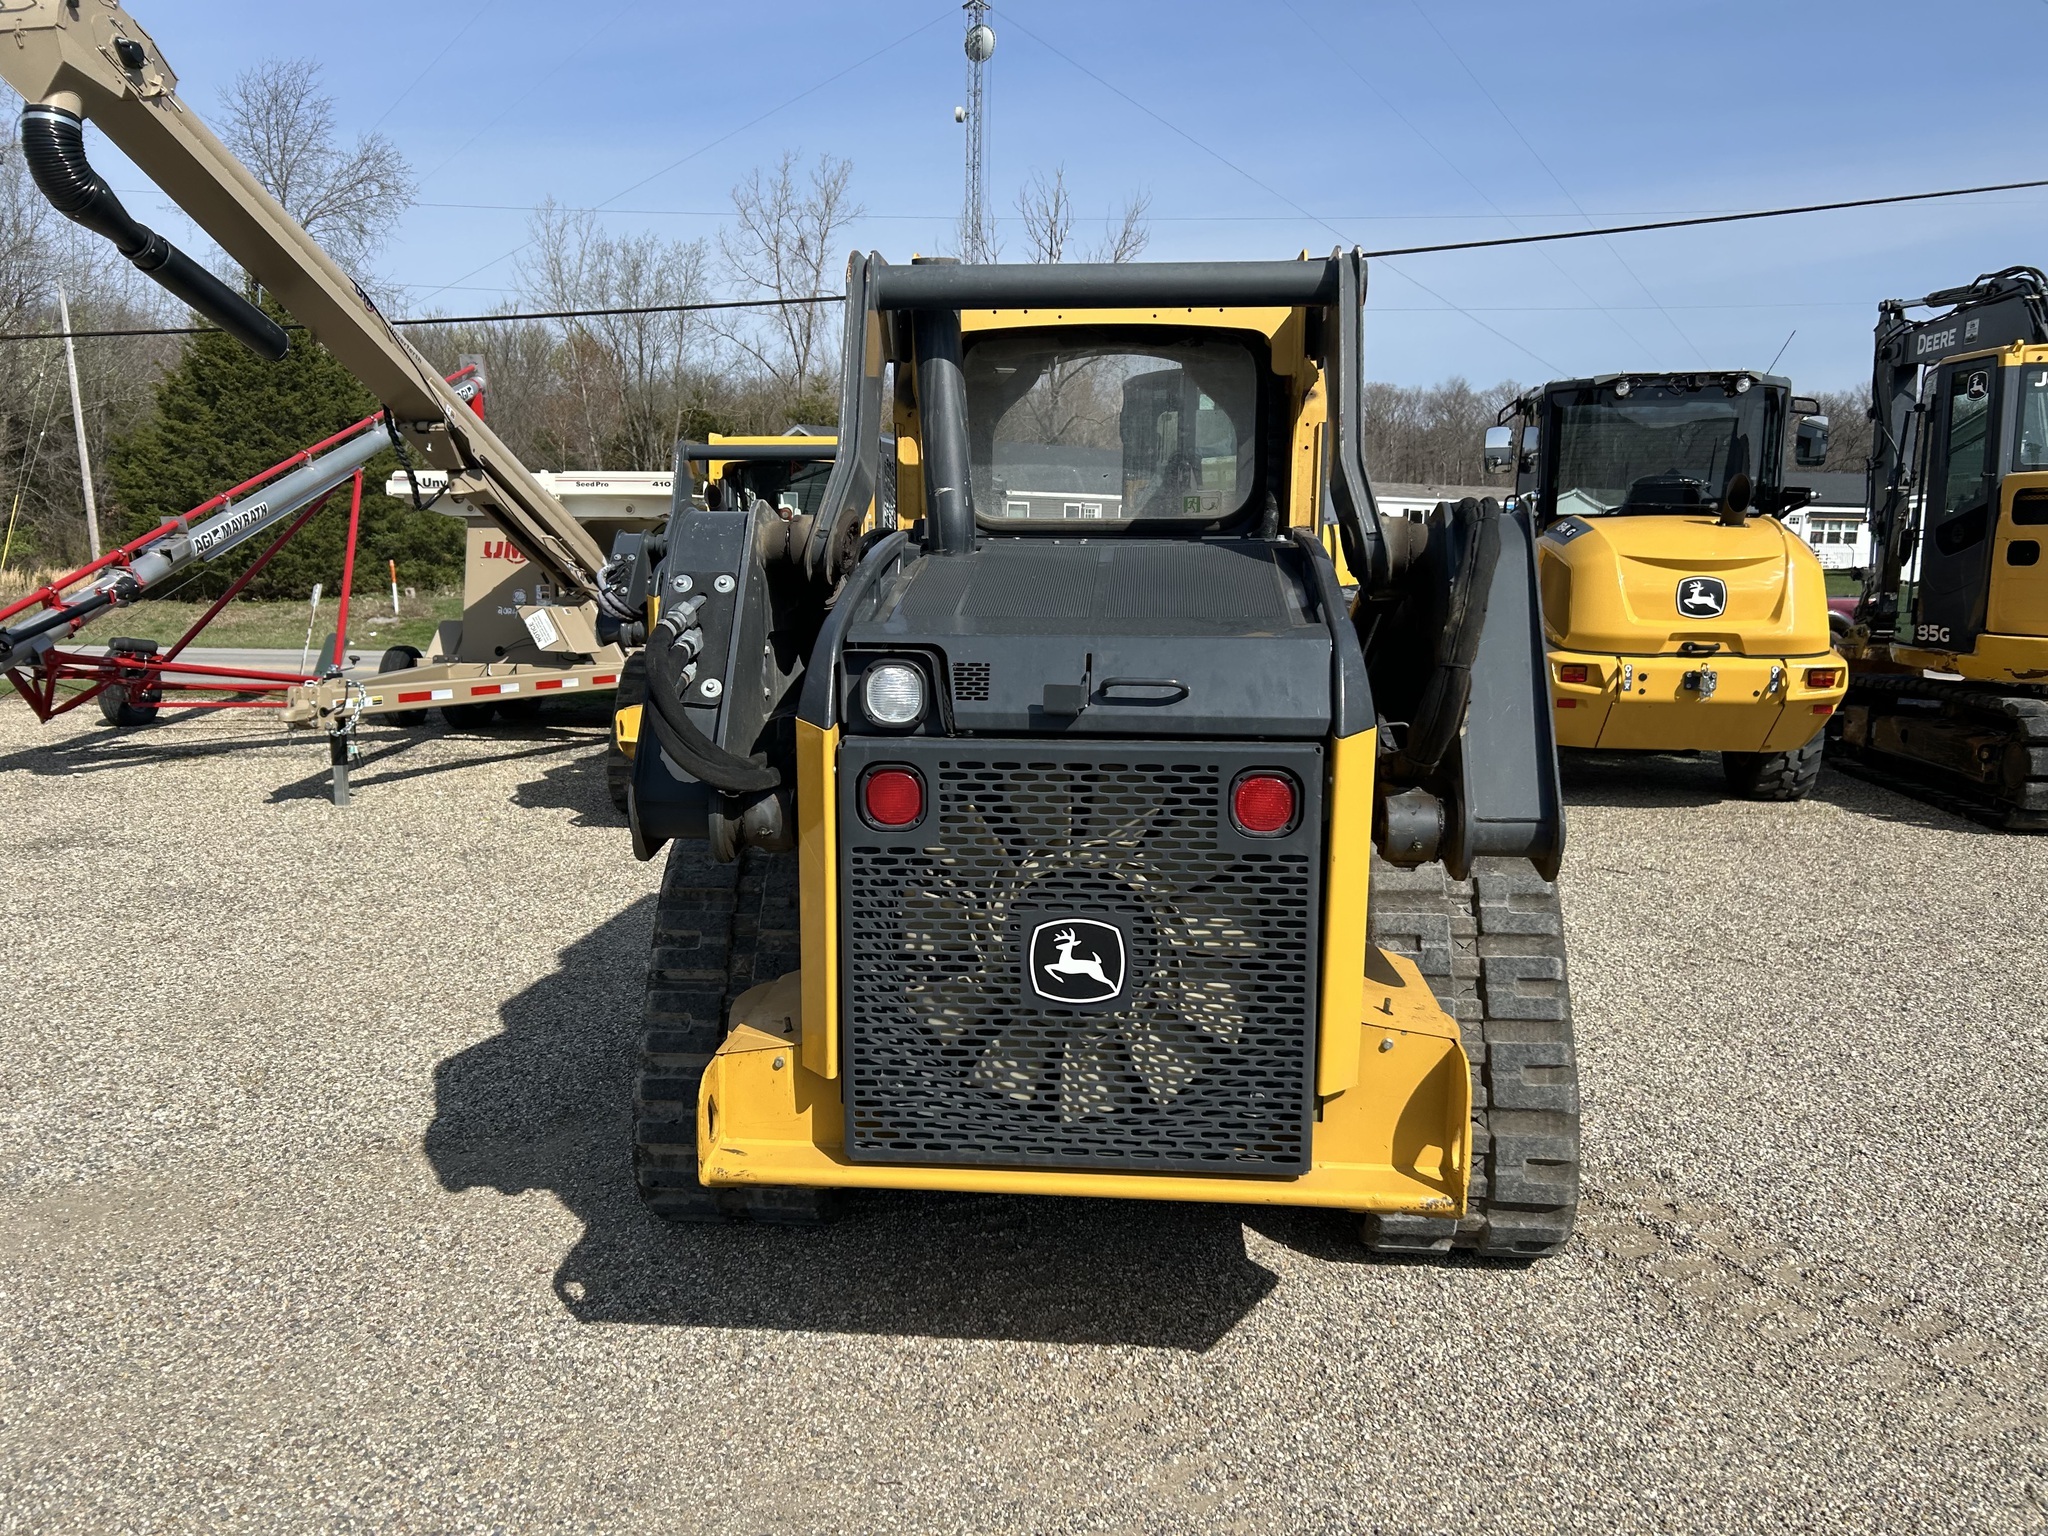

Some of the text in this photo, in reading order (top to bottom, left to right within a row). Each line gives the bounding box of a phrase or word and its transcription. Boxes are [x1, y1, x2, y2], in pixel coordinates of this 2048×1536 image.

[1917, 328, 1957, 355] DEERE
[2034, 371, 2048, 387] J
[194, 504, 268, 555] AGI MAYRATH
[528, 622, 542, 643] NOTICE
